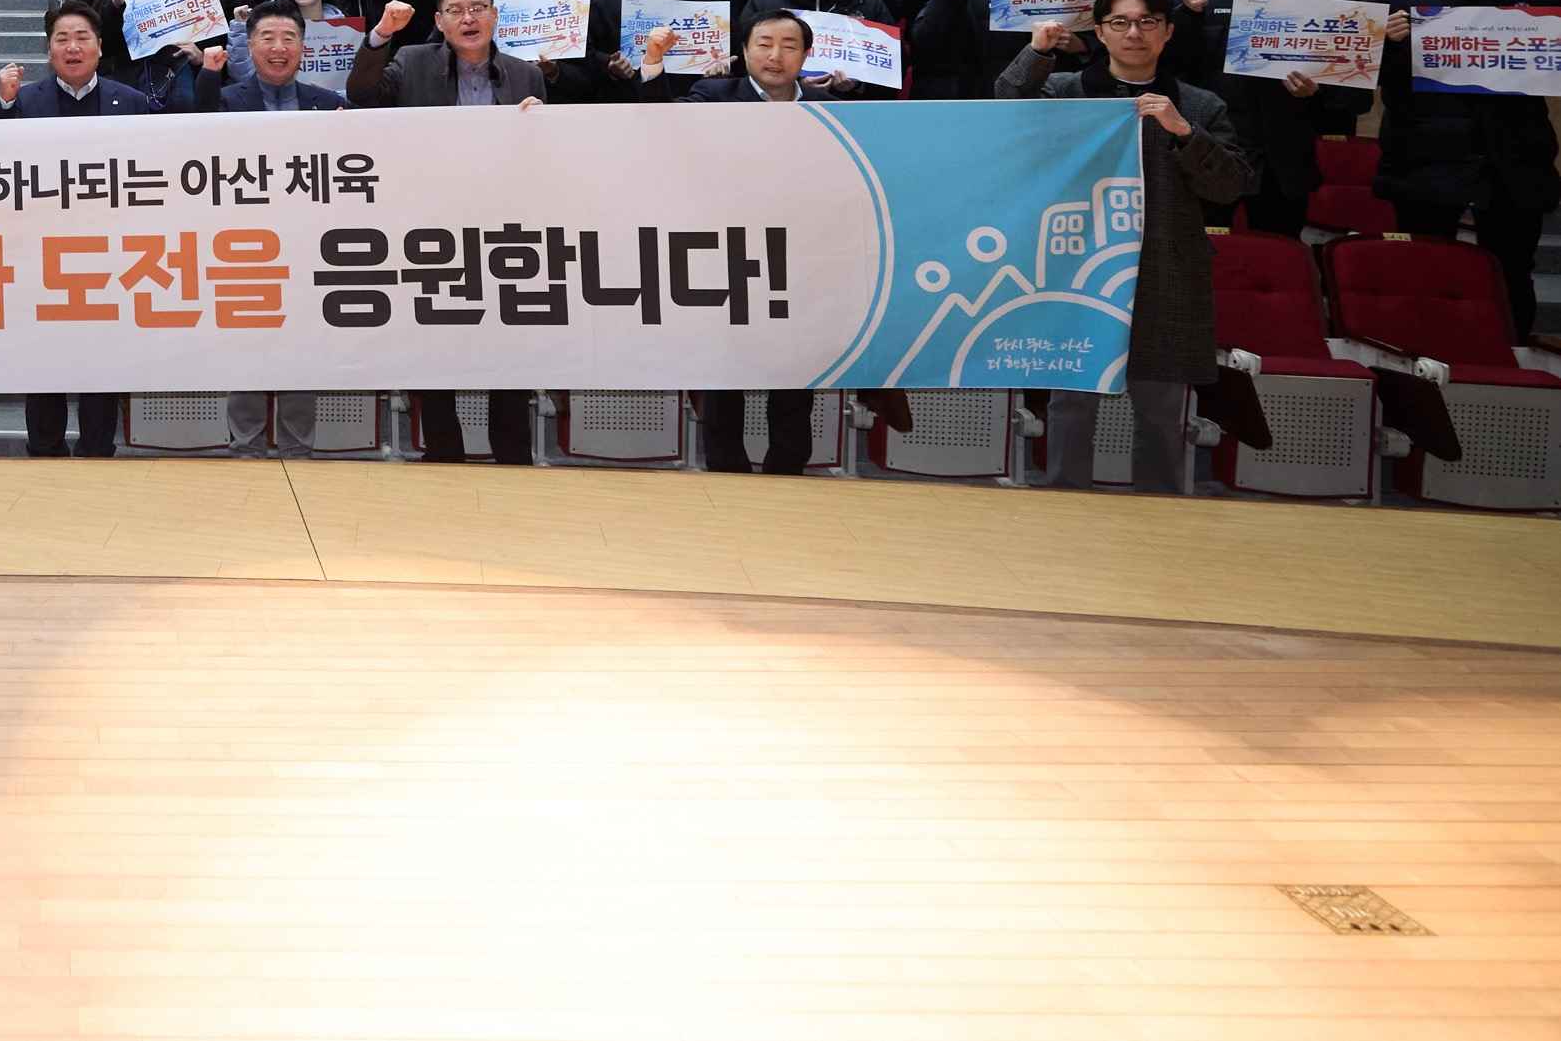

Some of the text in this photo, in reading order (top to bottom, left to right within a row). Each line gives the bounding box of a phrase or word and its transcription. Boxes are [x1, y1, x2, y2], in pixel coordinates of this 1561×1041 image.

[533, 4, 573, 20] 스포츠
[135, 18, 158, 34] 함께
[158, 9, 186, 25] 지키는
[498, 15, 581, 39] 함께 지키는 인권
[668, 16, 711, 29] 스포츠
[1238, 17, 1360, 34] 함께하는 스포츠
[690, 30, 721, 45] 인권
[1250, 34, 1371, 52] 함께 지키는 인권
[1421, 35, 1500, 52] 함께하는
[817, 47, 893, 71] 지키는 인권
[1422, 53, 1462, 70] 함께
[1466, 53, 1527, 71] 지키는
[179, 152, 273, 206] 아산
[284, 151, 380, 205] 체육
[35, 228, 290, 330] 도전을
[313, 222, 790, 329] 응원합니다!
[993, 337, 1024, 353] 다시
[1059, 336, 1095, 353] 아산
[1047, 356, 1087, 373] 시민
